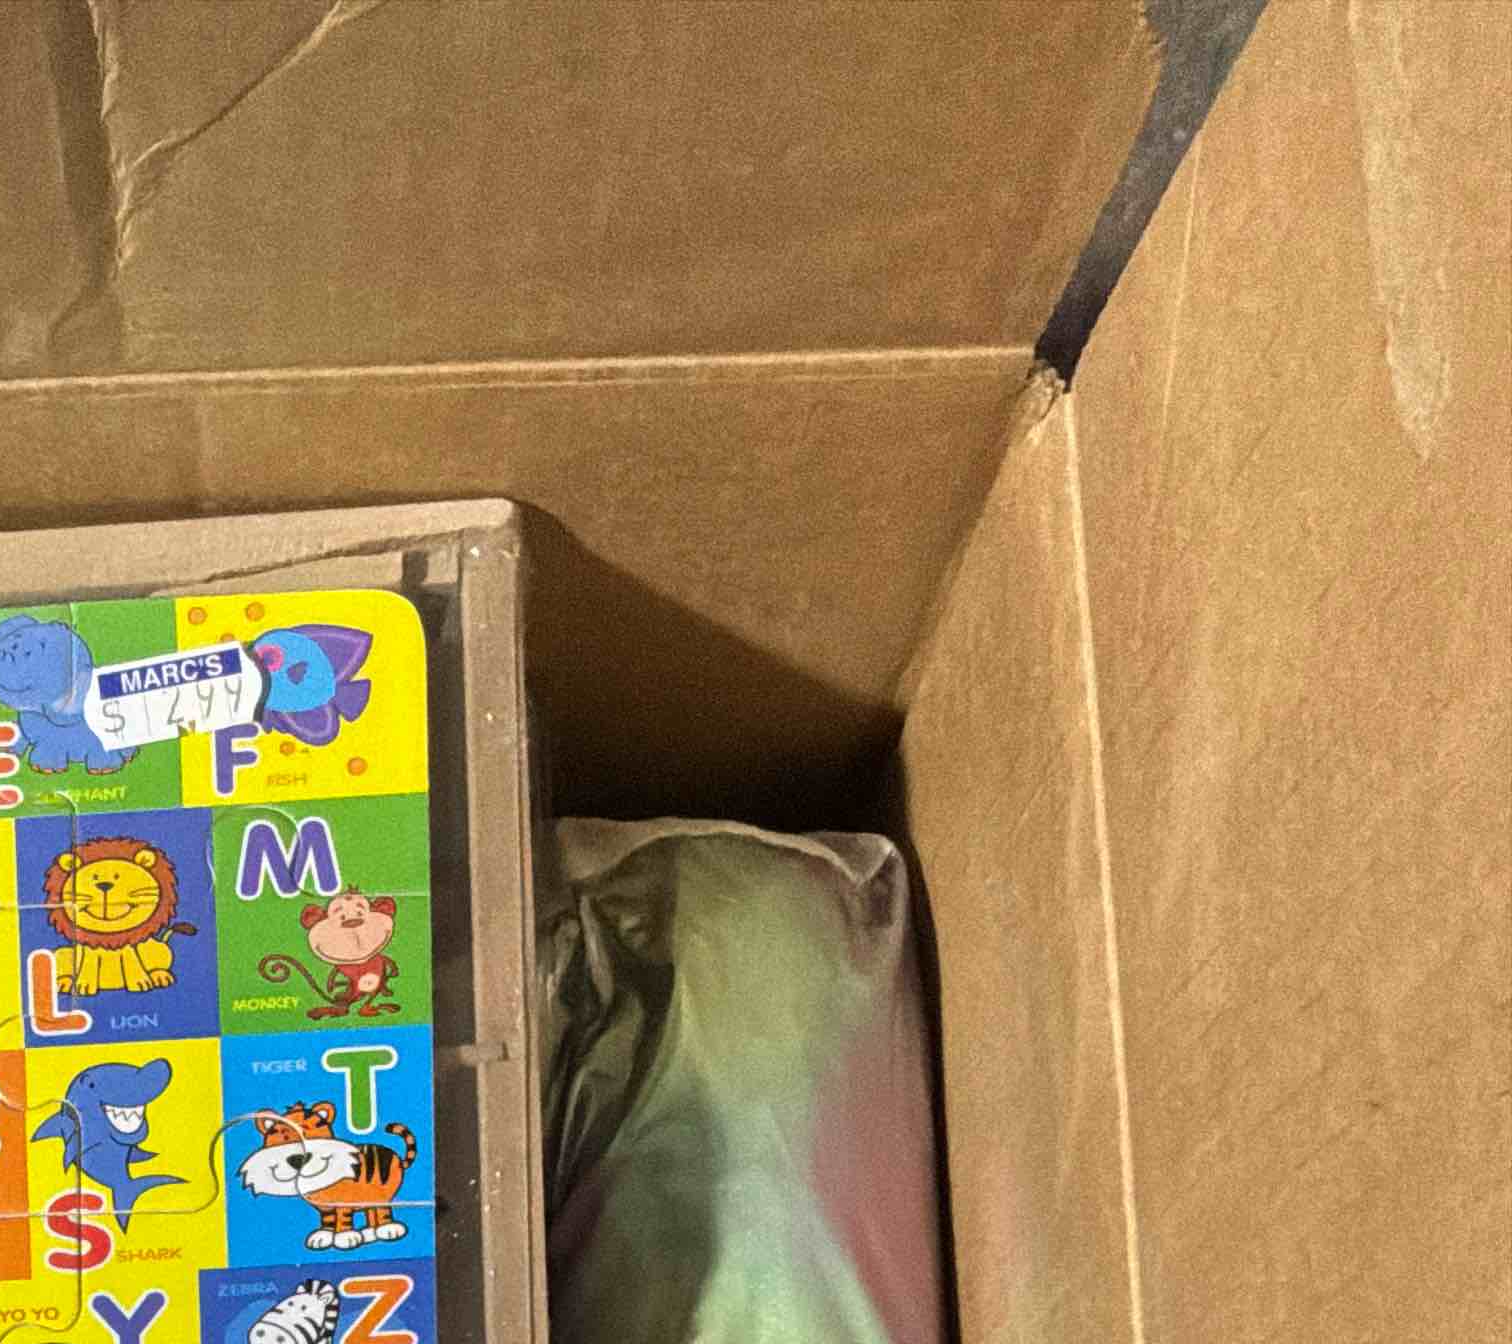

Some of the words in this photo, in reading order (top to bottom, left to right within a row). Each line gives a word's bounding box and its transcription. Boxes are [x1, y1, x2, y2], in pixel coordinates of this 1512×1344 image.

[120, 654, 224, 694] MARC'S
[210, 722, 264, 796] F
[266, 773, 309, 788] FISH
[236, 817, 341, 900] M
[27, 948, 91, 1036] L
[232, 996, 300, 1014] MONKEY
[110, 1012, 161, 1031] LION
[251, 1058, 307, 1075] TIGER
[321, 1045, 398, 1135] T
[44, 1188, 113, 1272] S
[116, 1247, 182, 1264] SHARK
[217, 1280, 279, 1298] ZEBRA
[30, 1305, 61, 1322] YO
